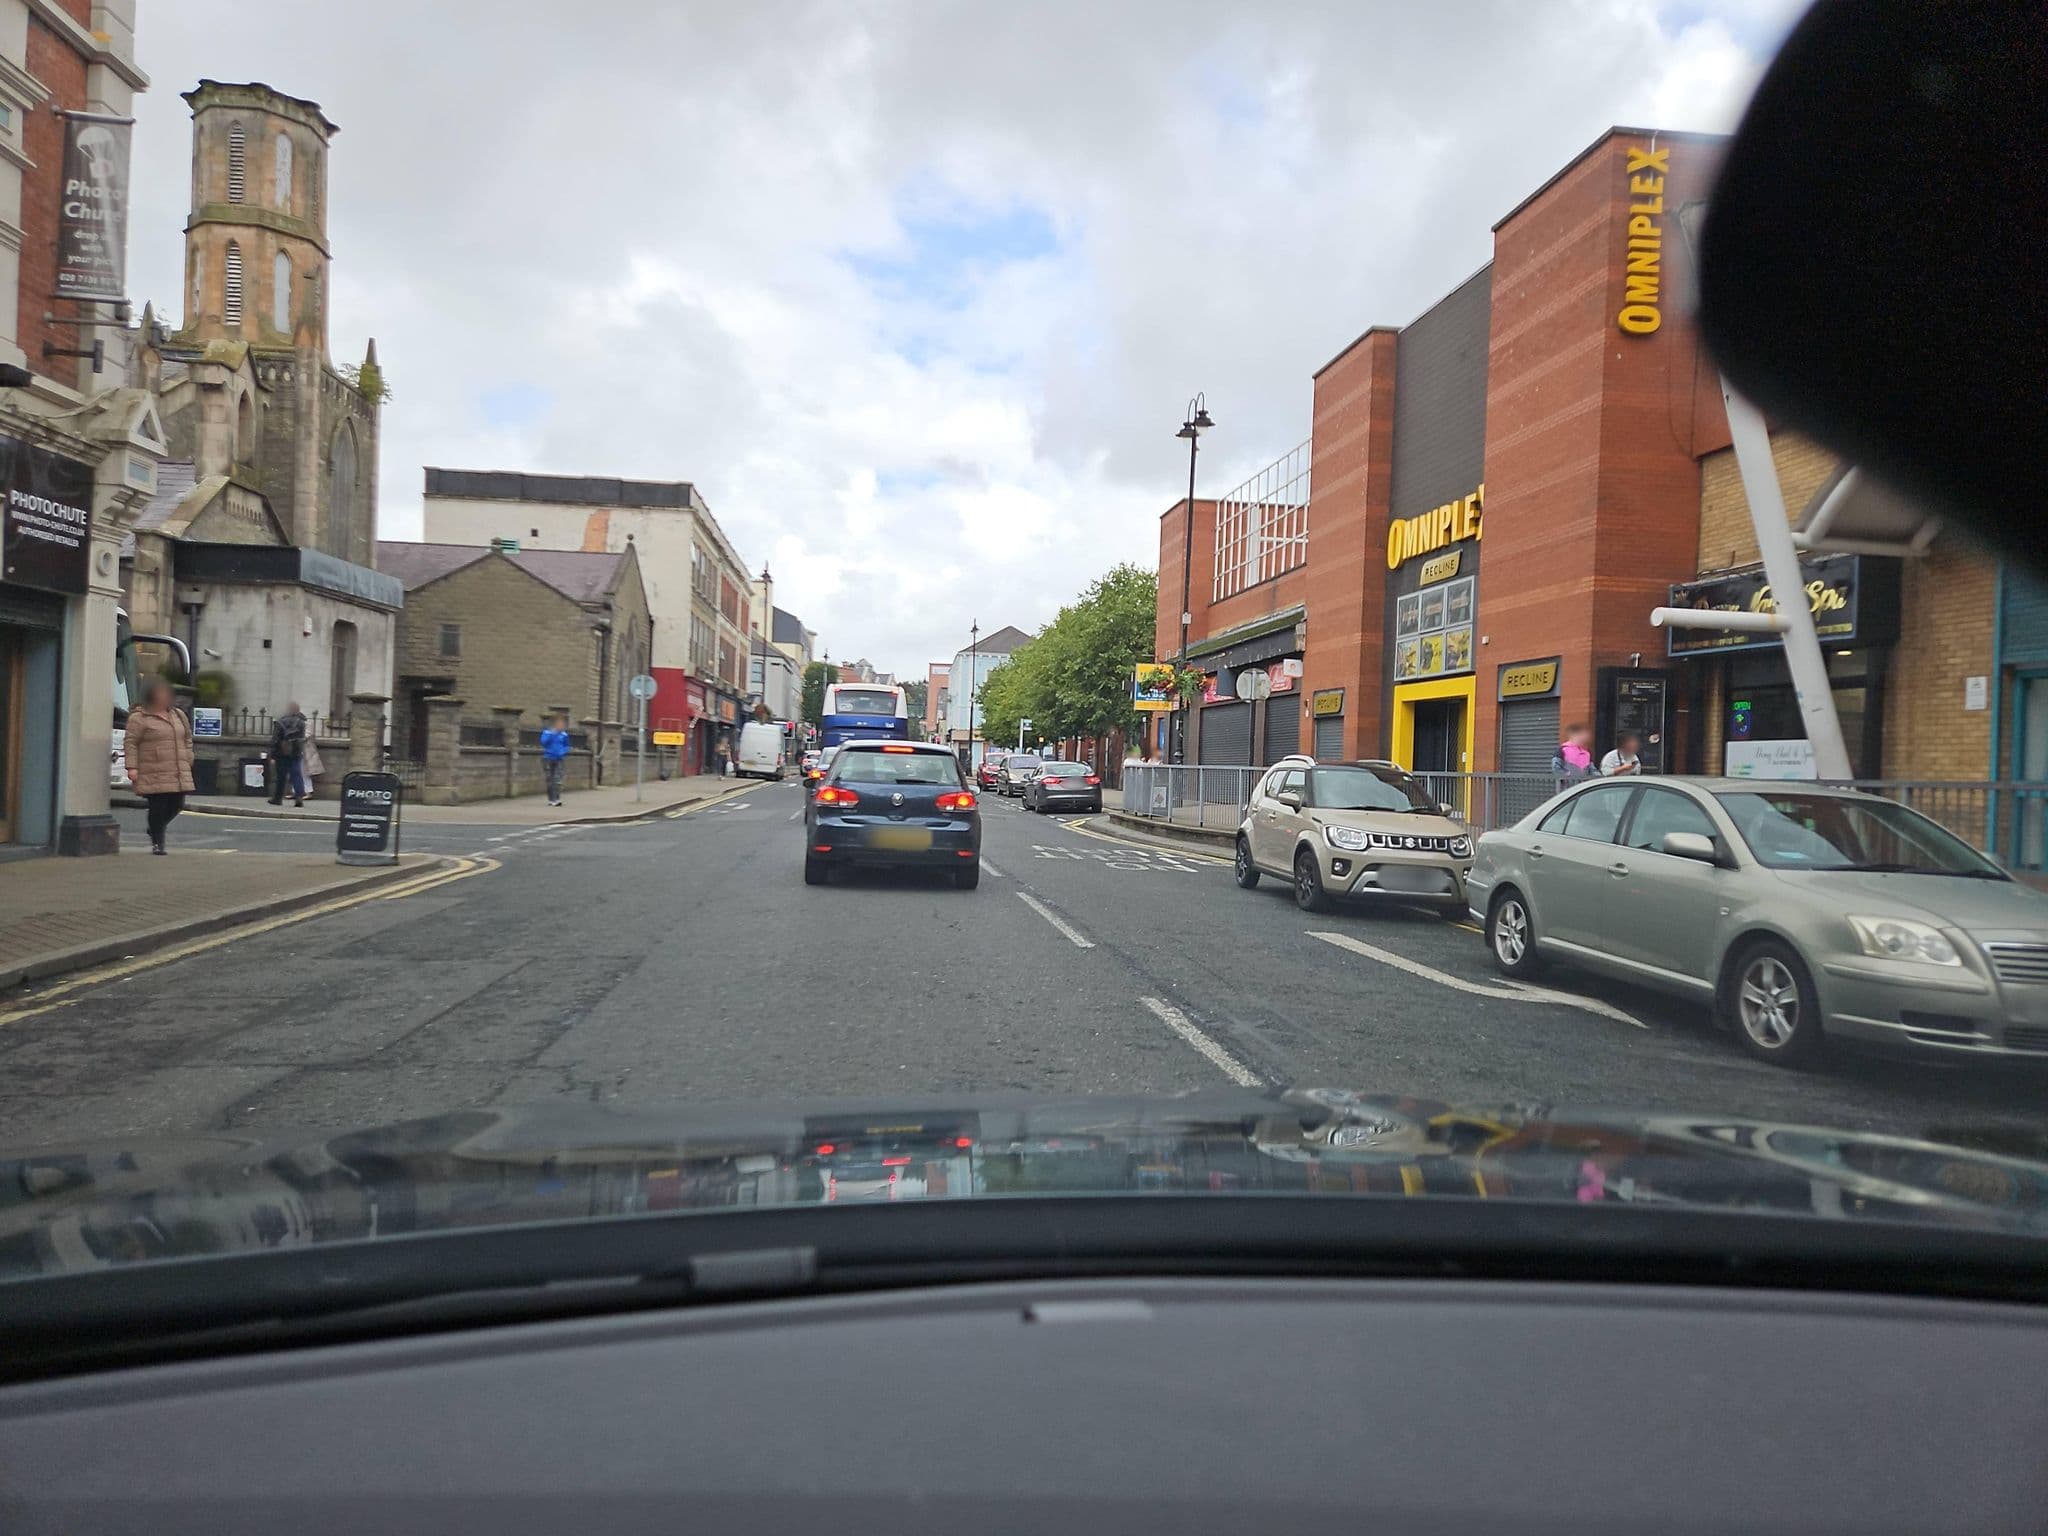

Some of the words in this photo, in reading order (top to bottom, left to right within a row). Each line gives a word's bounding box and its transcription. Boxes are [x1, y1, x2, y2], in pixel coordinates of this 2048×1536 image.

[1618, 147, 1669, 335] OMNIPLEX
[10, 489, 87, 525] PHOTOCHUTE
[1425, 559, 1455, 577] RECLINE
[1508, 671, 1549, 688] RECLINE
[347, 789, 392, 800] PHOTO
